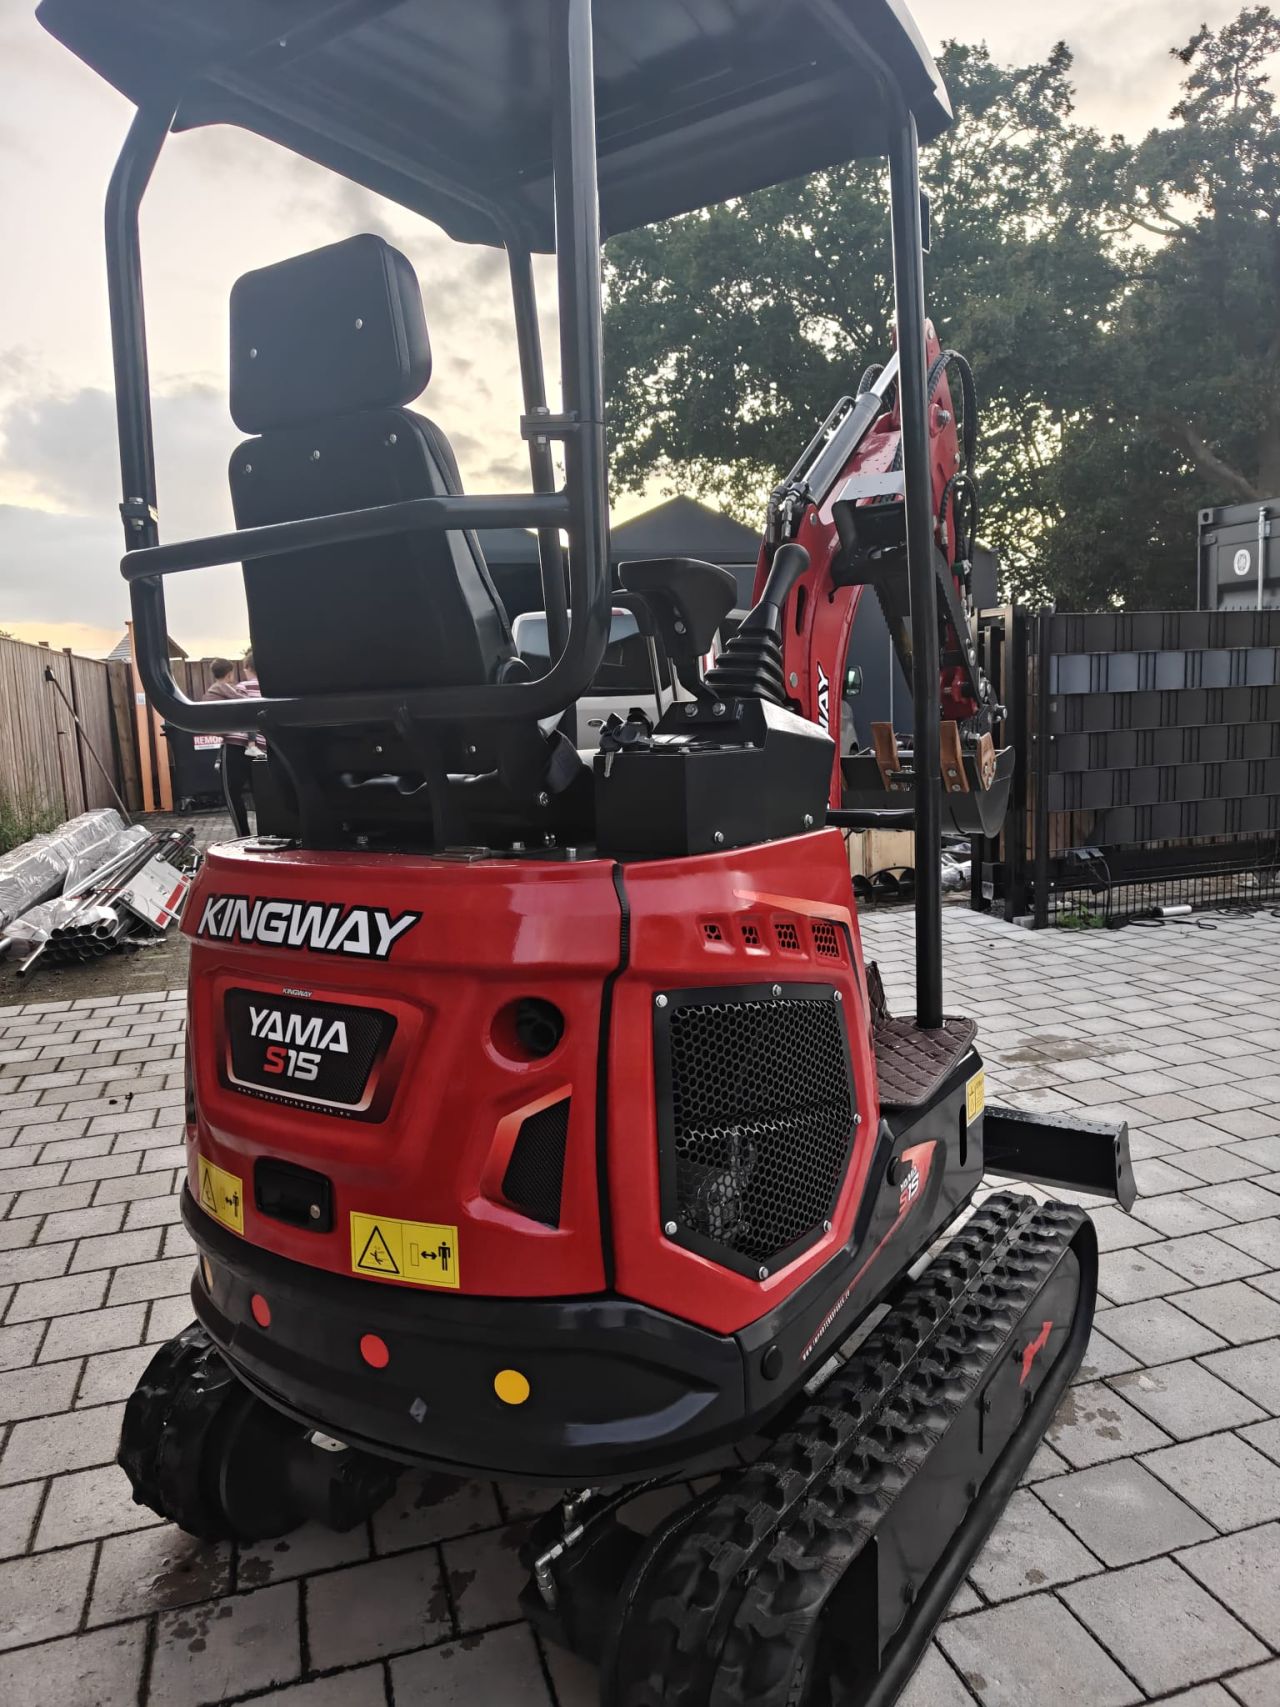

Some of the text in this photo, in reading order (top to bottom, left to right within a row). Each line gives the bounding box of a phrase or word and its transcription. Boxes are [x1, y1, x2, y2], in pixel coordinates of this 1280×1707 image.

[197, 896, 419, 957] KINGWAY
[282, 988, 312, 997] KINGWAY
[249, 1006, 349, 1053] YAMA
[263, 1045, 322, 1080] S15
